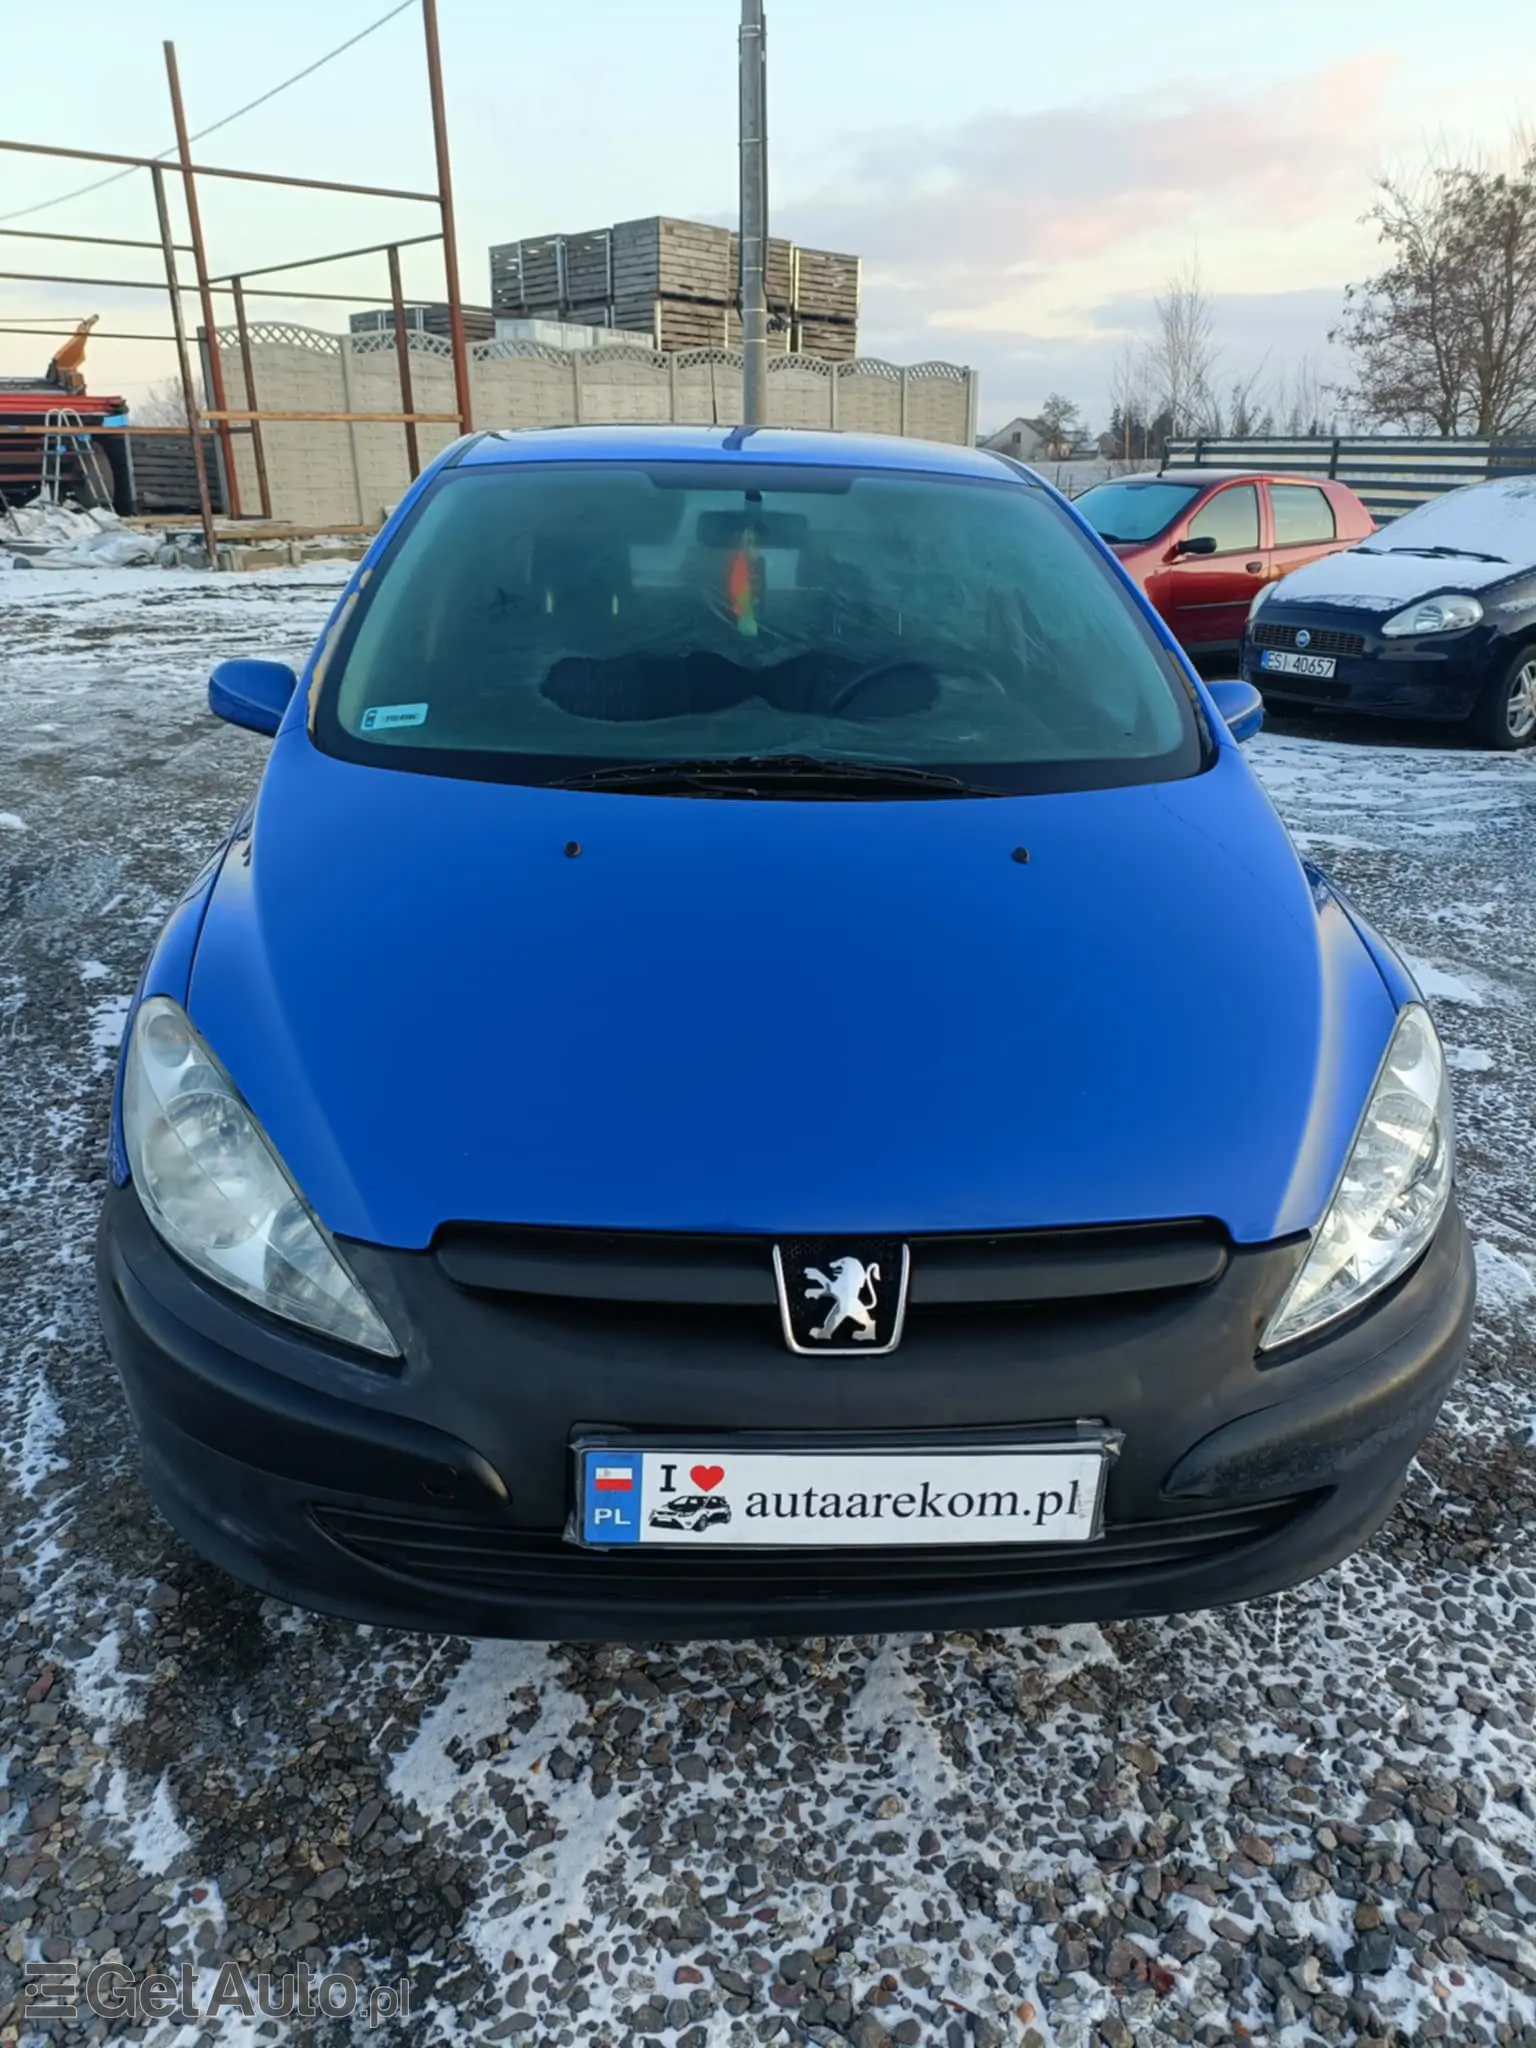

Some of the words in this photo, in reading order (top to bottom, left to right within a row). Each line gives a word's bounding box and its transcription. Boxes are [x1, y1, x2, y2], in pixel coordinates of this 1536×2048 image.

[1267, 653, 1288, 670] ESI
[1293, 656, 1334, 676] 40657
[660, 1464, 677, 1493] I
[745, 1479, 1081, 1526] autaarekom.pl
[594, 1508, 631, 1526] PL
